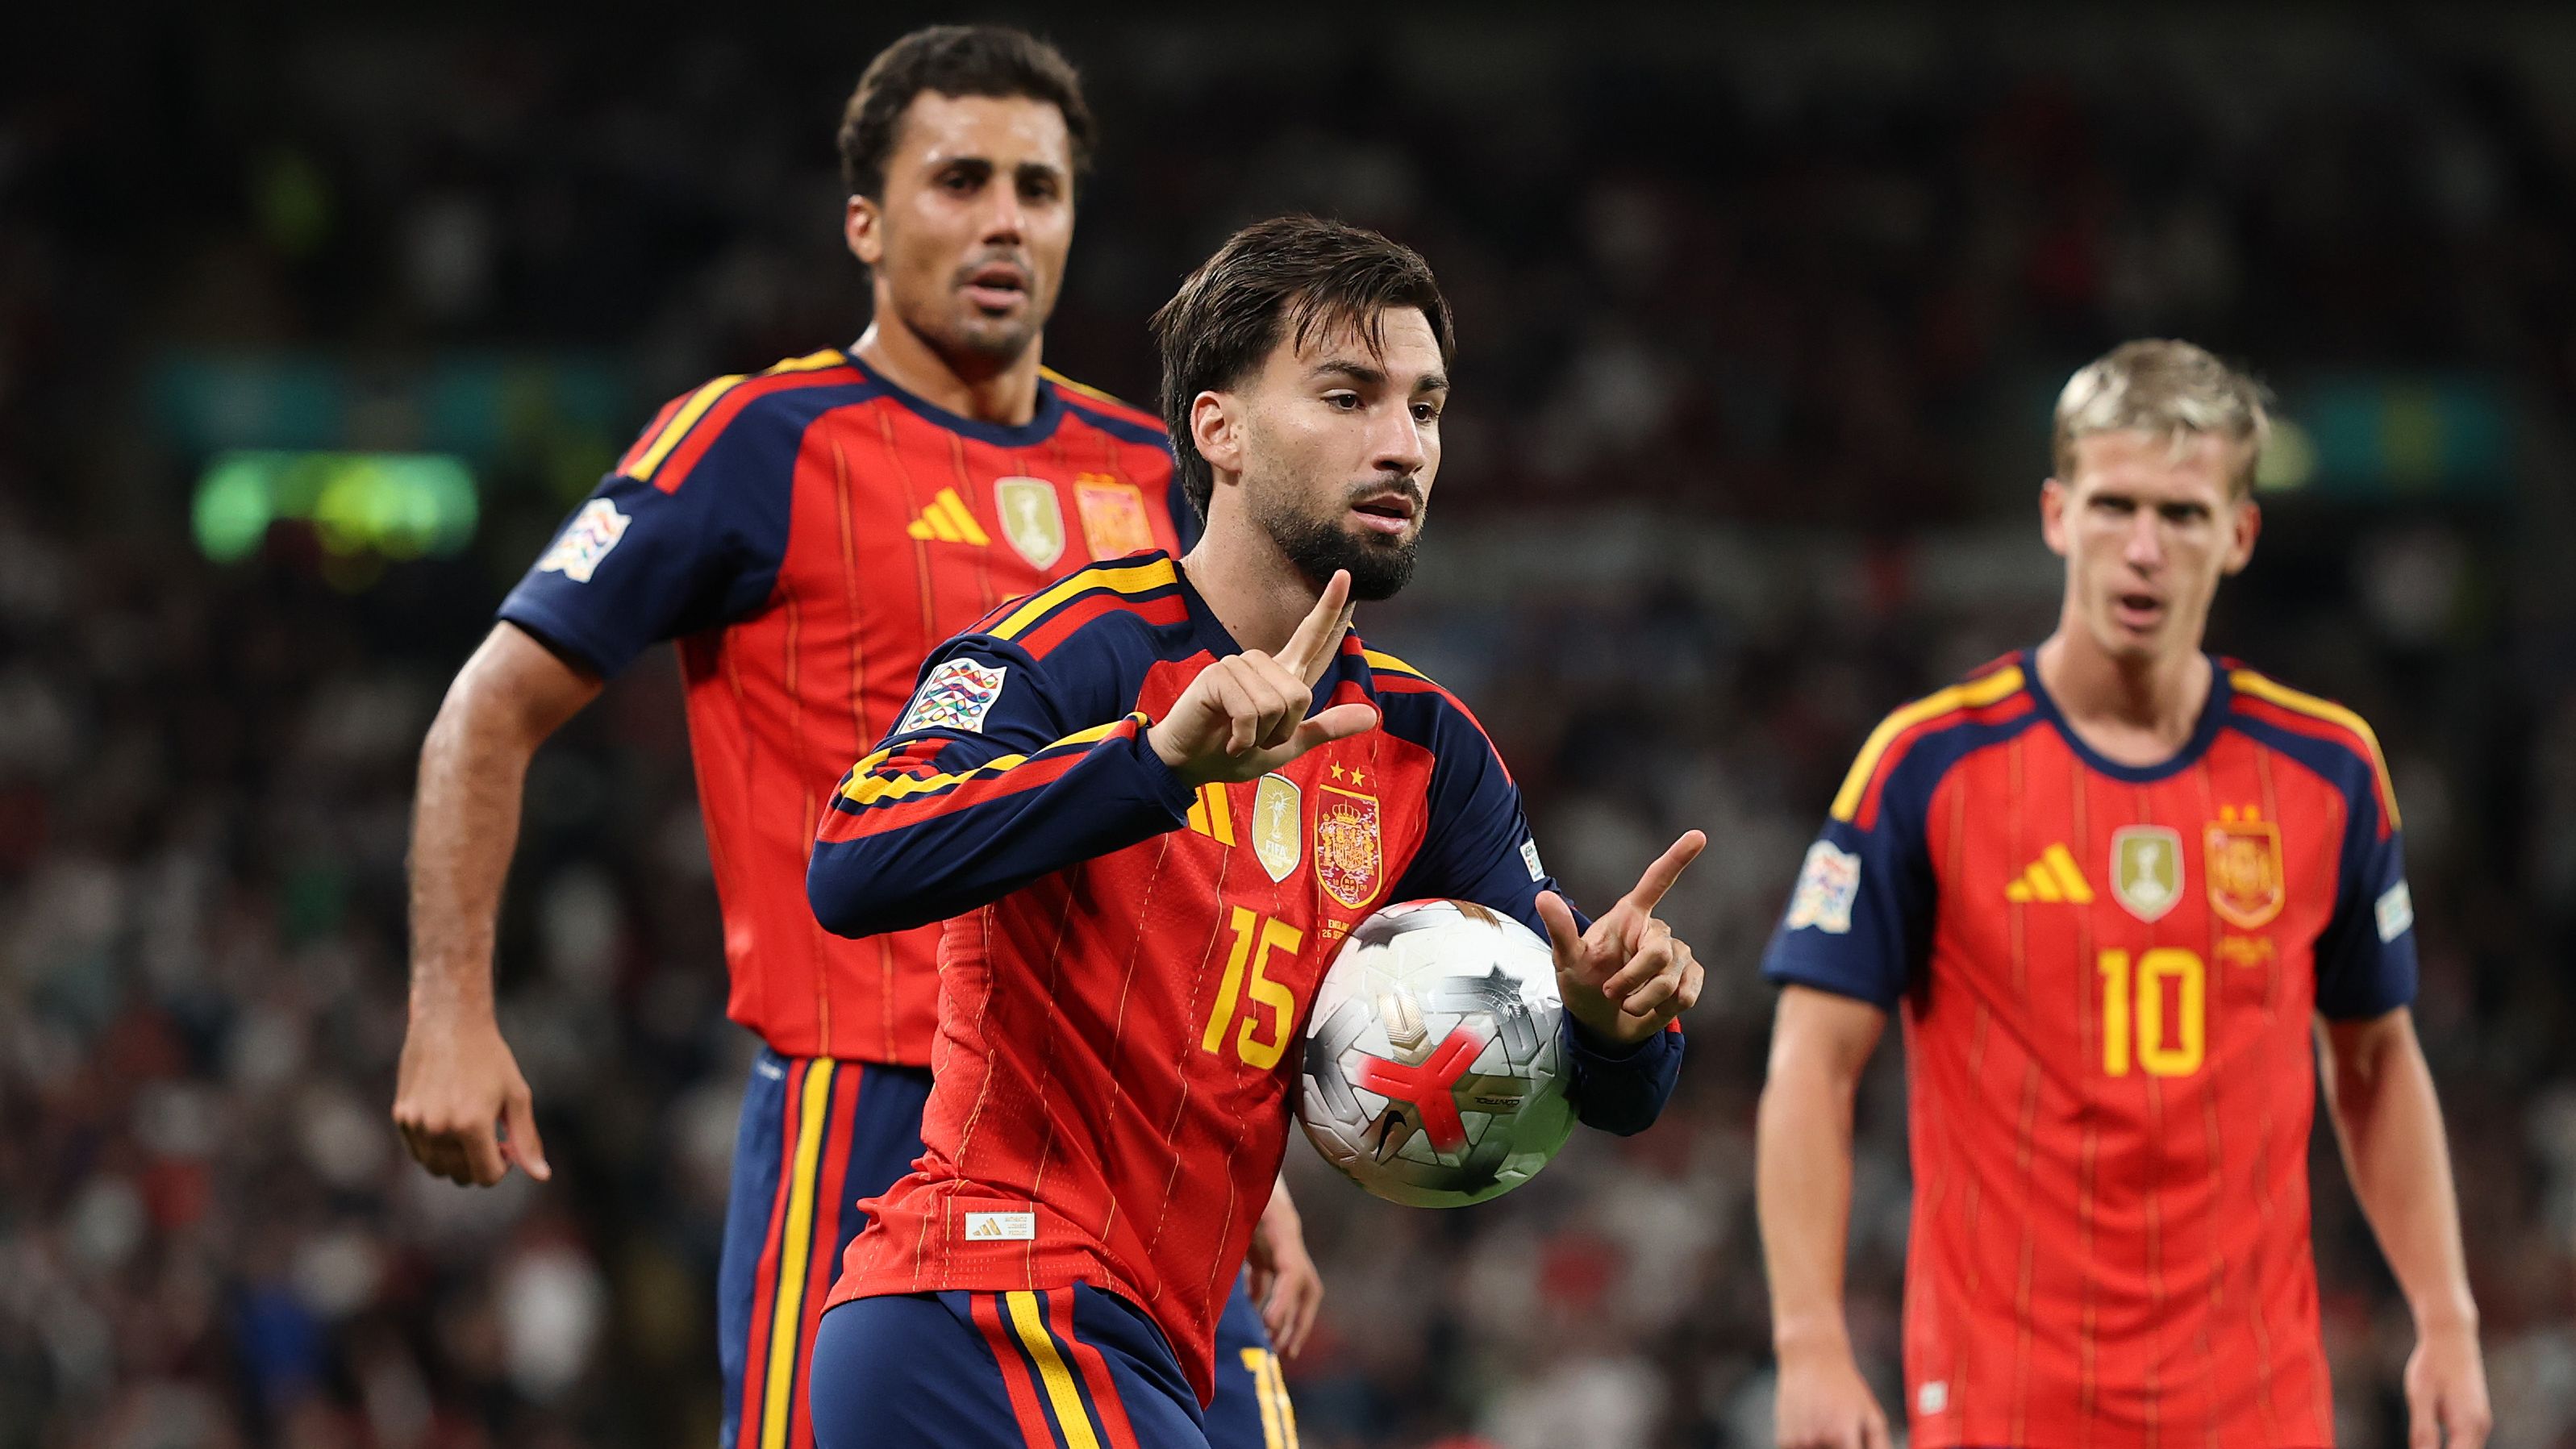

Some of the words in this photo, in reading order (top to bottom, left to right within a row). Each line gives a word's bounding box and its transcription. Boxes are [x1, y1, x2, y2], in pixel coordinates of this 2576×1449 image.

[1265, 839, 1286, 859] FIFA
[1322, 928, 1332, 939] 26
[1328, 918, 1350, 932] ENGLAN
[1202, 905, 1304, 1070] 15
[2099, 948, 2205, 1076] 10
[1240, 1347, 1300, 1449] 1
